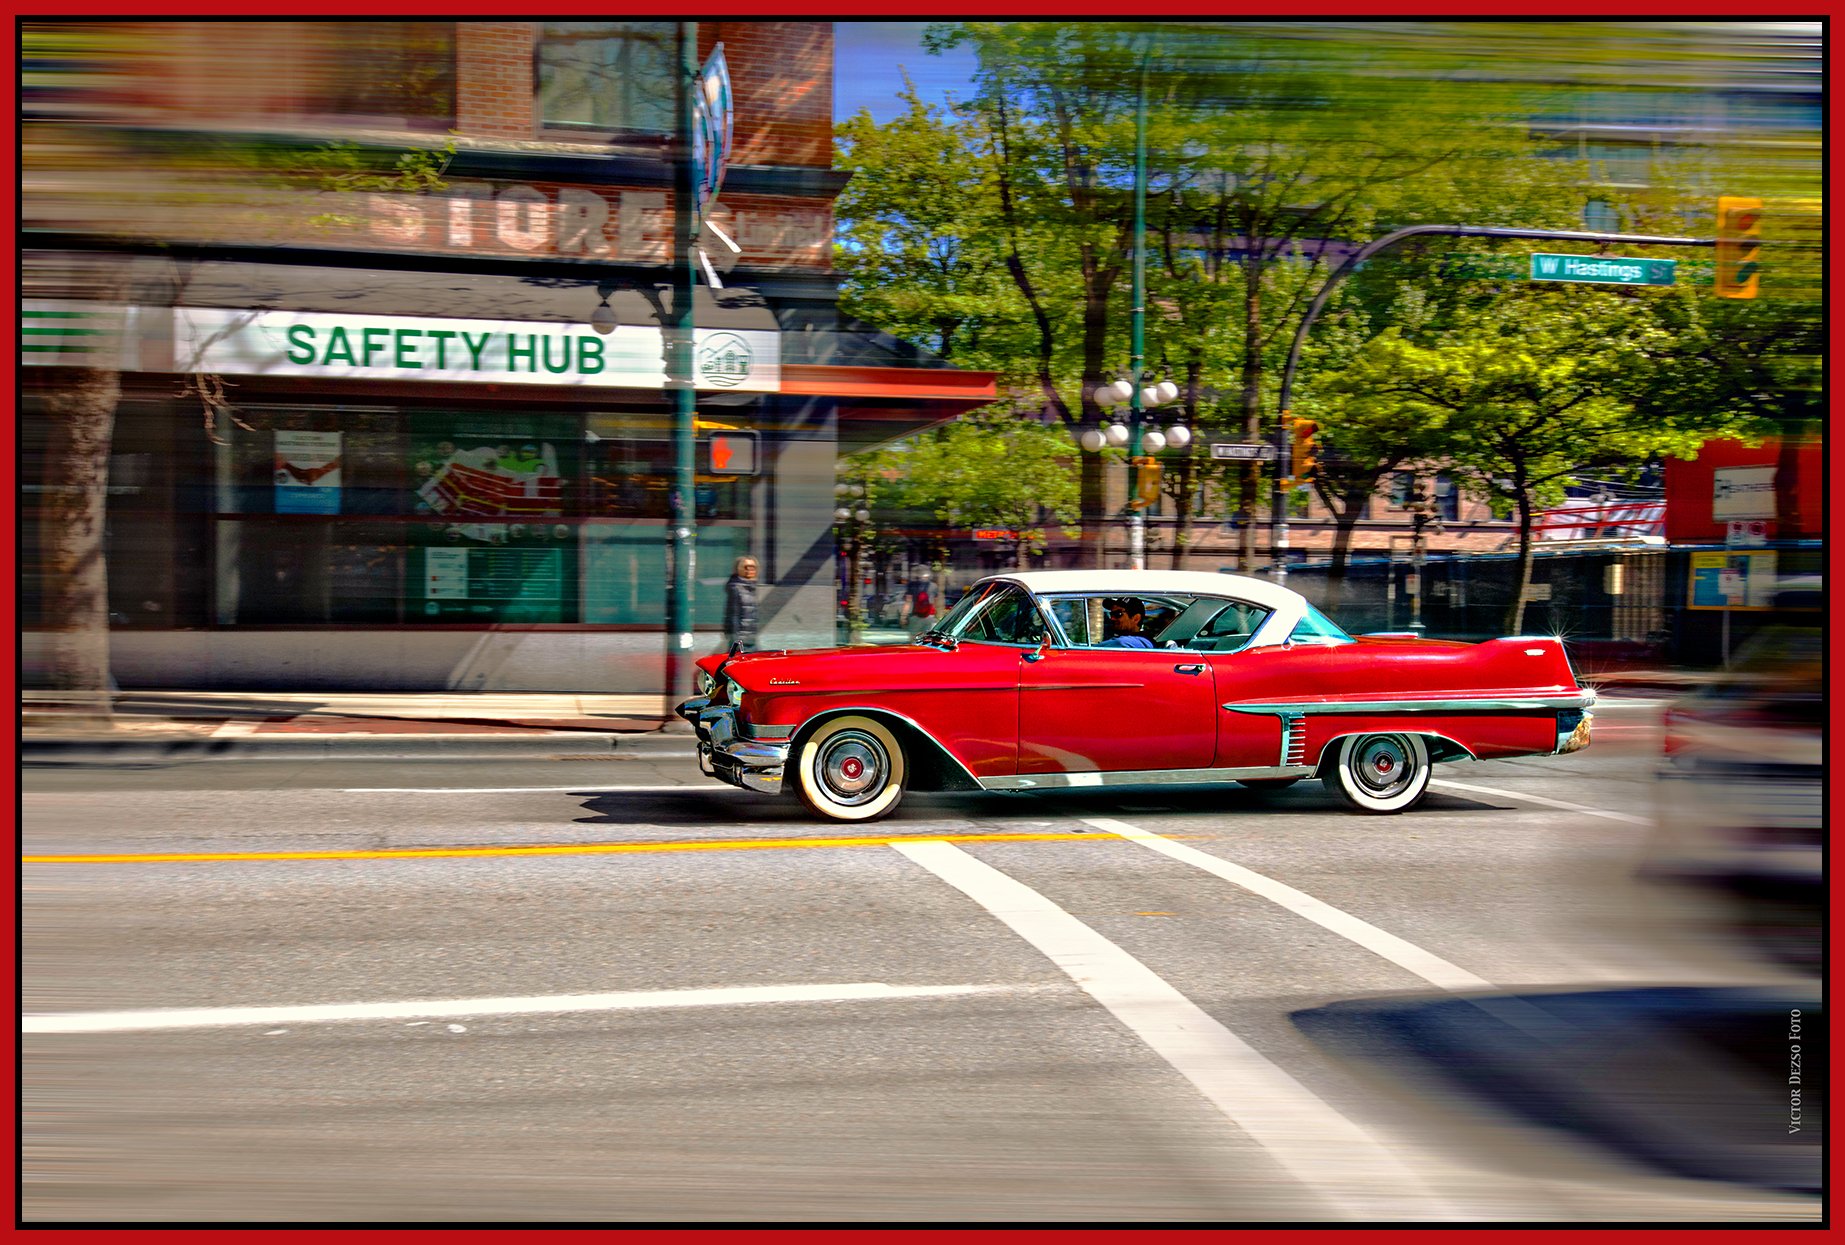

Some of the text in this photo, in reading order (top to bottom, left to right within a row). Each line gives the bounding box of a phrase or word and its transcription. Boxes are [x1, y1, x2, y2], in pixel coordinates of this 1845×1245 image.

[1539, 256, 1560, 274] W
[1564, 258, 1643, 282] Hastings
[287, 324, 606, 374] SAFETY HUB
